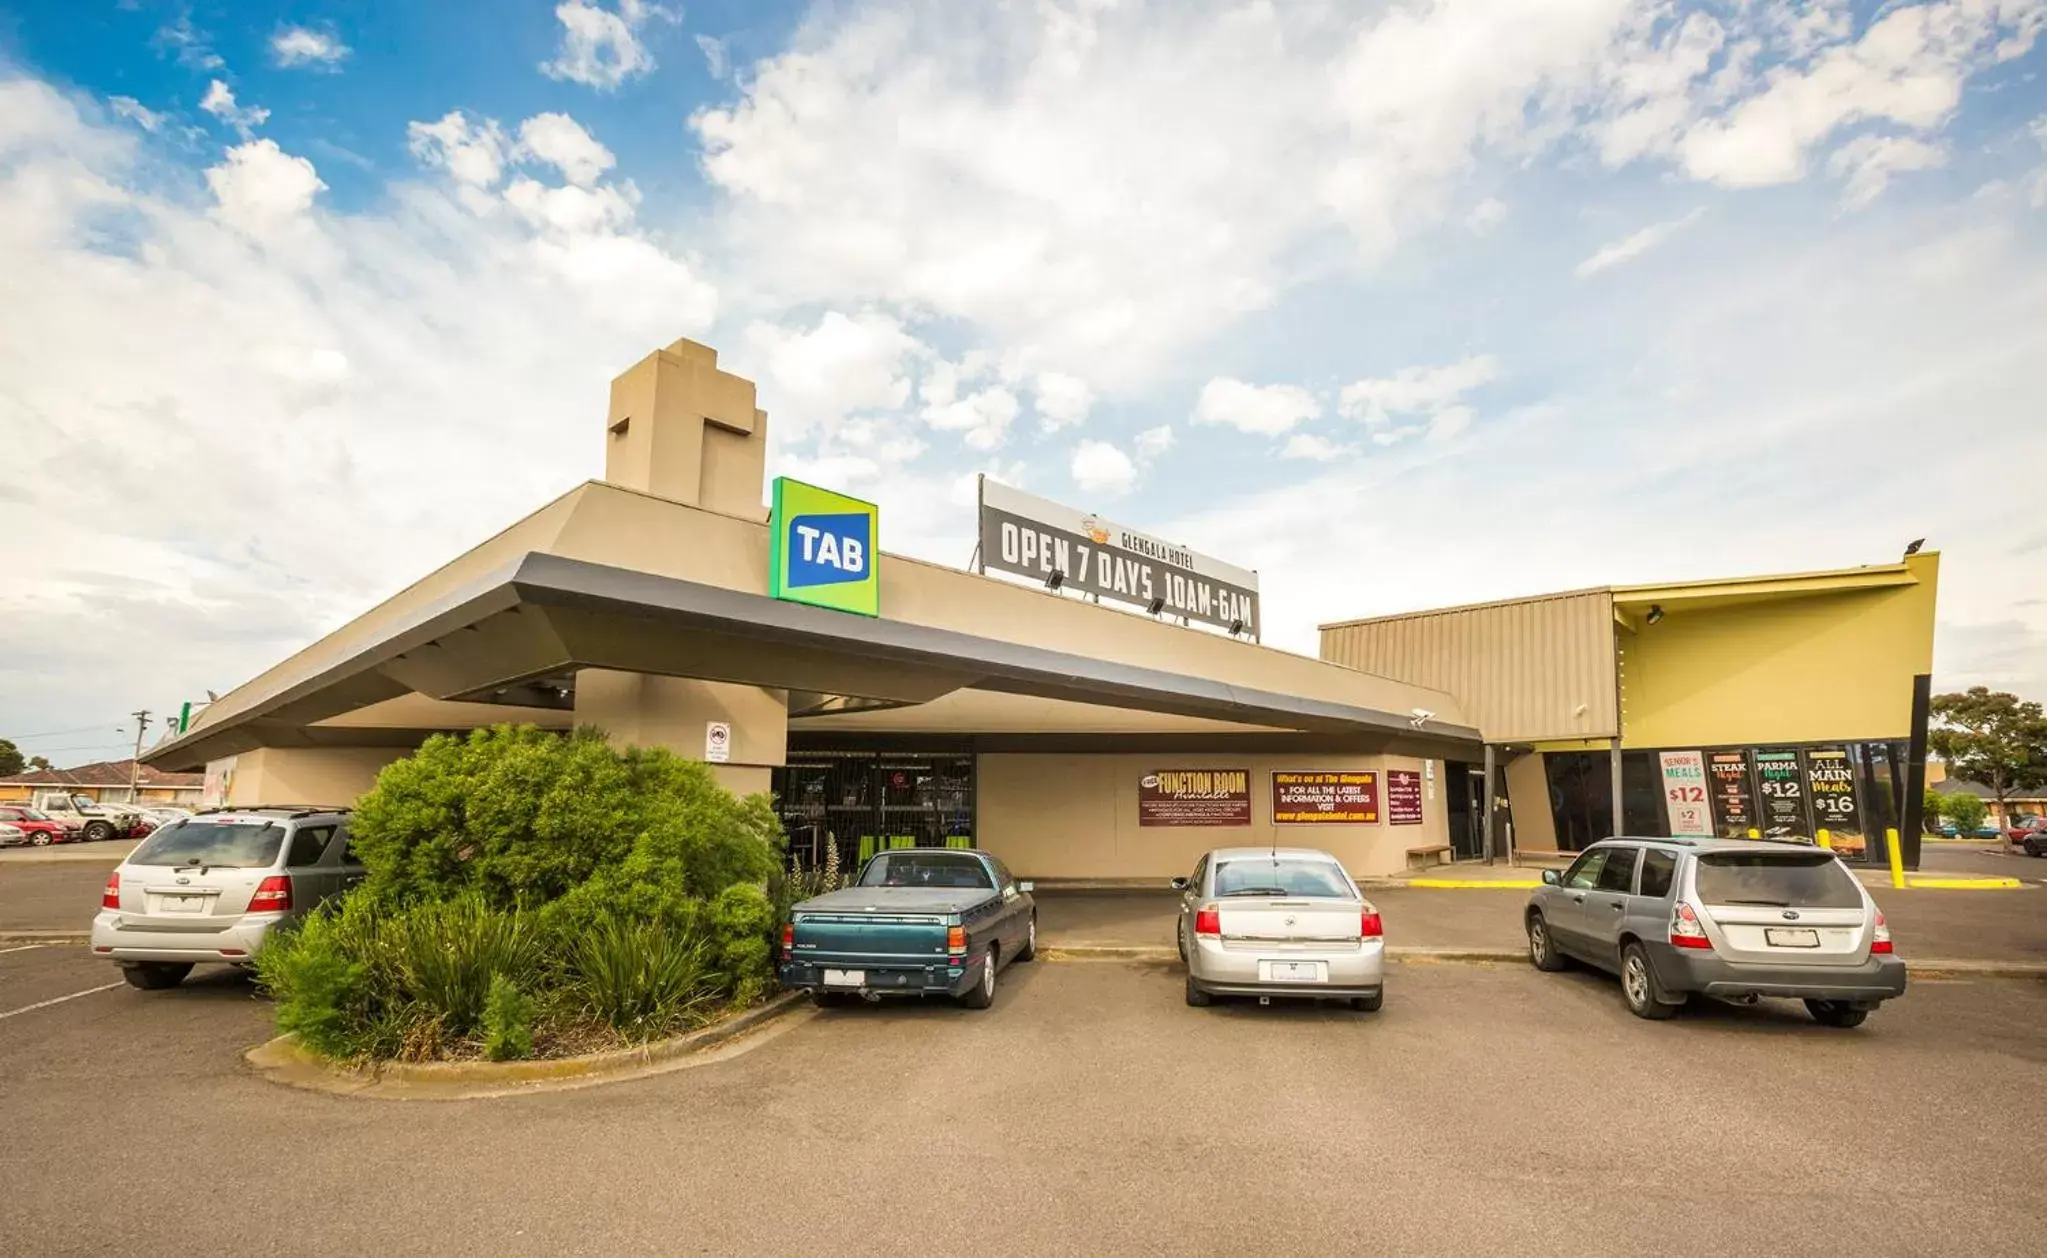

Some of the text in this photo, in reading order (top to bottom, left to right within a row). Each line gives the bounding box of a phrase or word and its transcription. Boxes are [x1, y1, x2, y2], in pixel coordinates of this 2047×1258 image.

[797, 525, 863, 573] TAB
[1121, 532, 1193, 570] GLENGALA HOTEL
[1002, 522, 1252, 627] OPEN 7 DAYS 10AM-6AM
[1711, 763, 1747, 771] STEAK
[1757, 761, 1798, 770] PARMA
[1815, 759, 1843, 770] ALL
[1665, 767, 1702, 777] MEALS
[1809, 769, 1852, 781] MAIN
[1158, 772, 1211, 793] FUNCTION
[1325, 774, 1338, 783] The
[1290, 786, 1361, 794] FOR ALL THE LATEST
[1762, 782, 1800, 797] $12
[1811, 781, 1852, 792] Meals
[1174, 789, 1230, 800] Available
[1281, 795, 1333, 803] INFORMATION
[1343, 795, 1370, 803] OFFERS
[1669, 786, 1704, 802] $12
[1317, 803, 1334, 811] VISIT
[1816, 796, 1854, 812] $16
